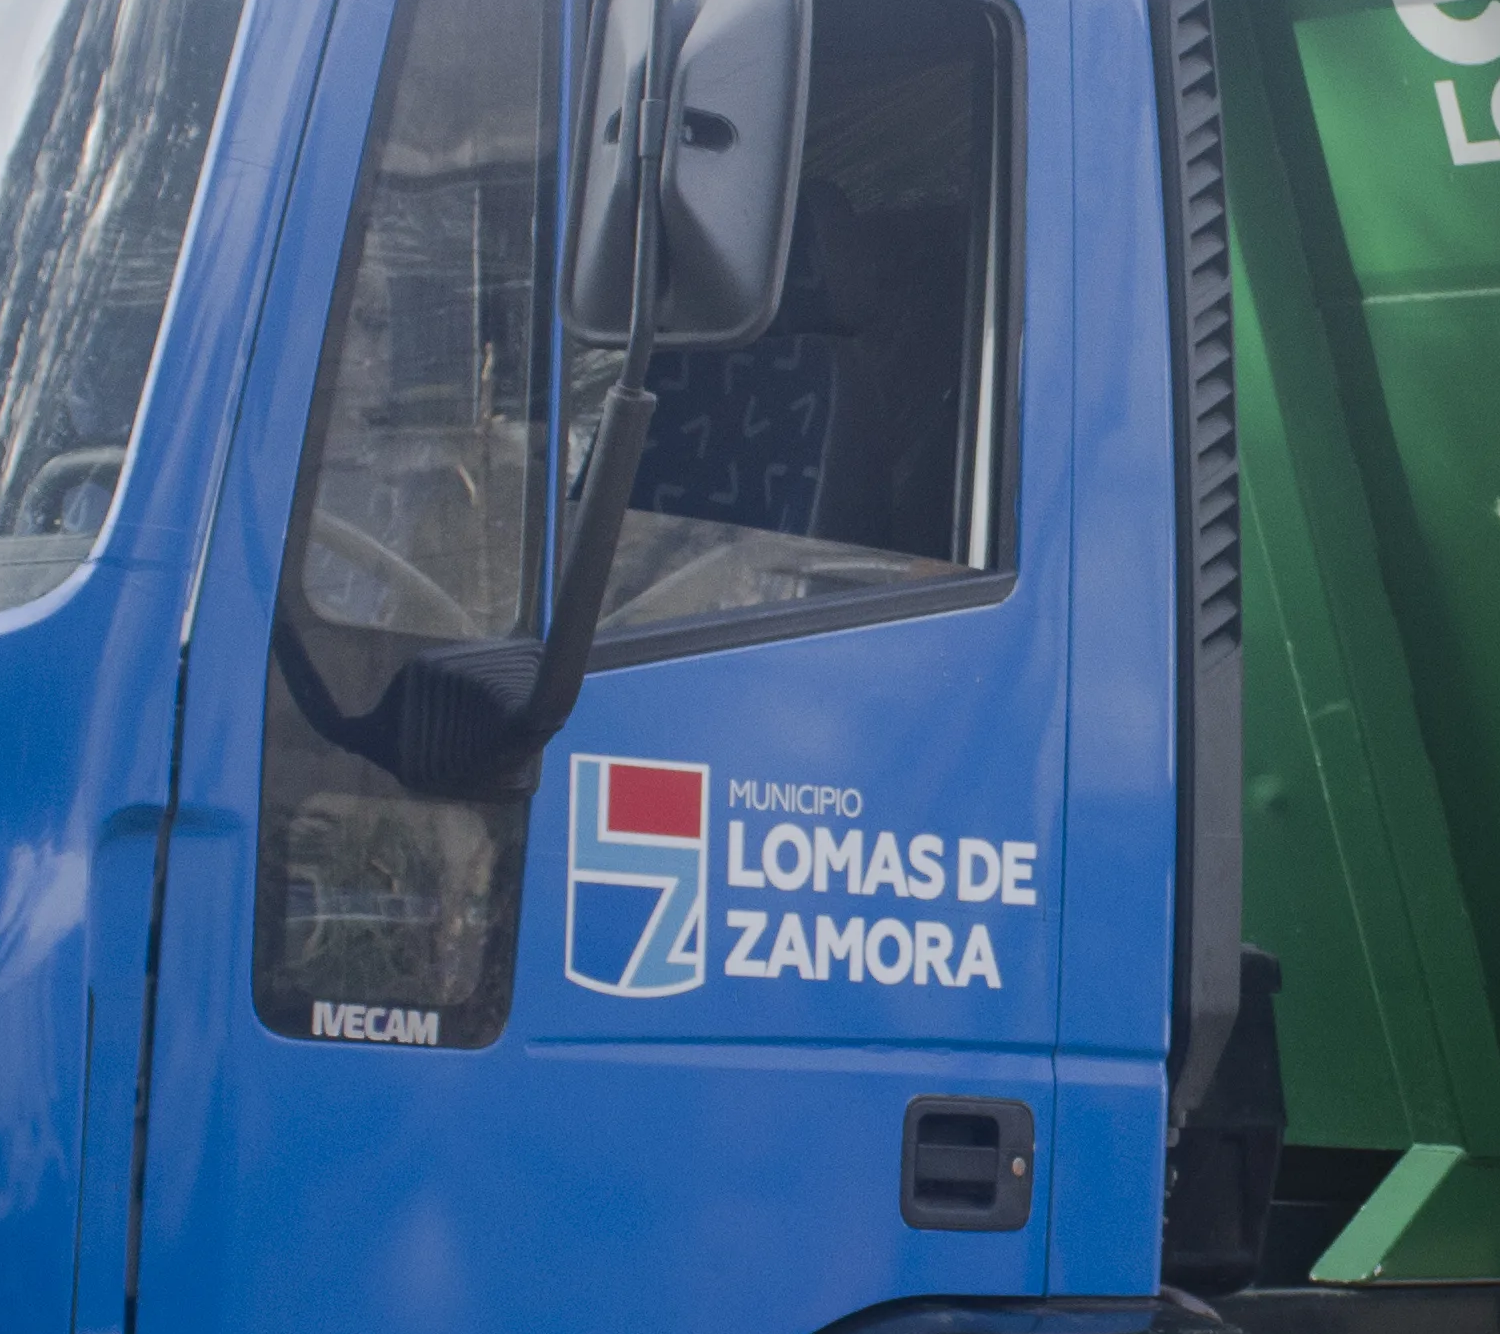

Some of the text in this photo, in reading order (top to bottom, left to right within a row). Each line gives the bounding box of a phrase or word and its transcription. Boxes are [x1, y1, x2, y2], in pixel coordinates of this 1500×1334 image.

[729, 778, 863, 818] MUNICIPIO
[727, 820, 1038, 905] LOMAS DE
[725, 912, 1002, 988] ZAMORA
[312, 1001, 438, 1046] IVECAM
